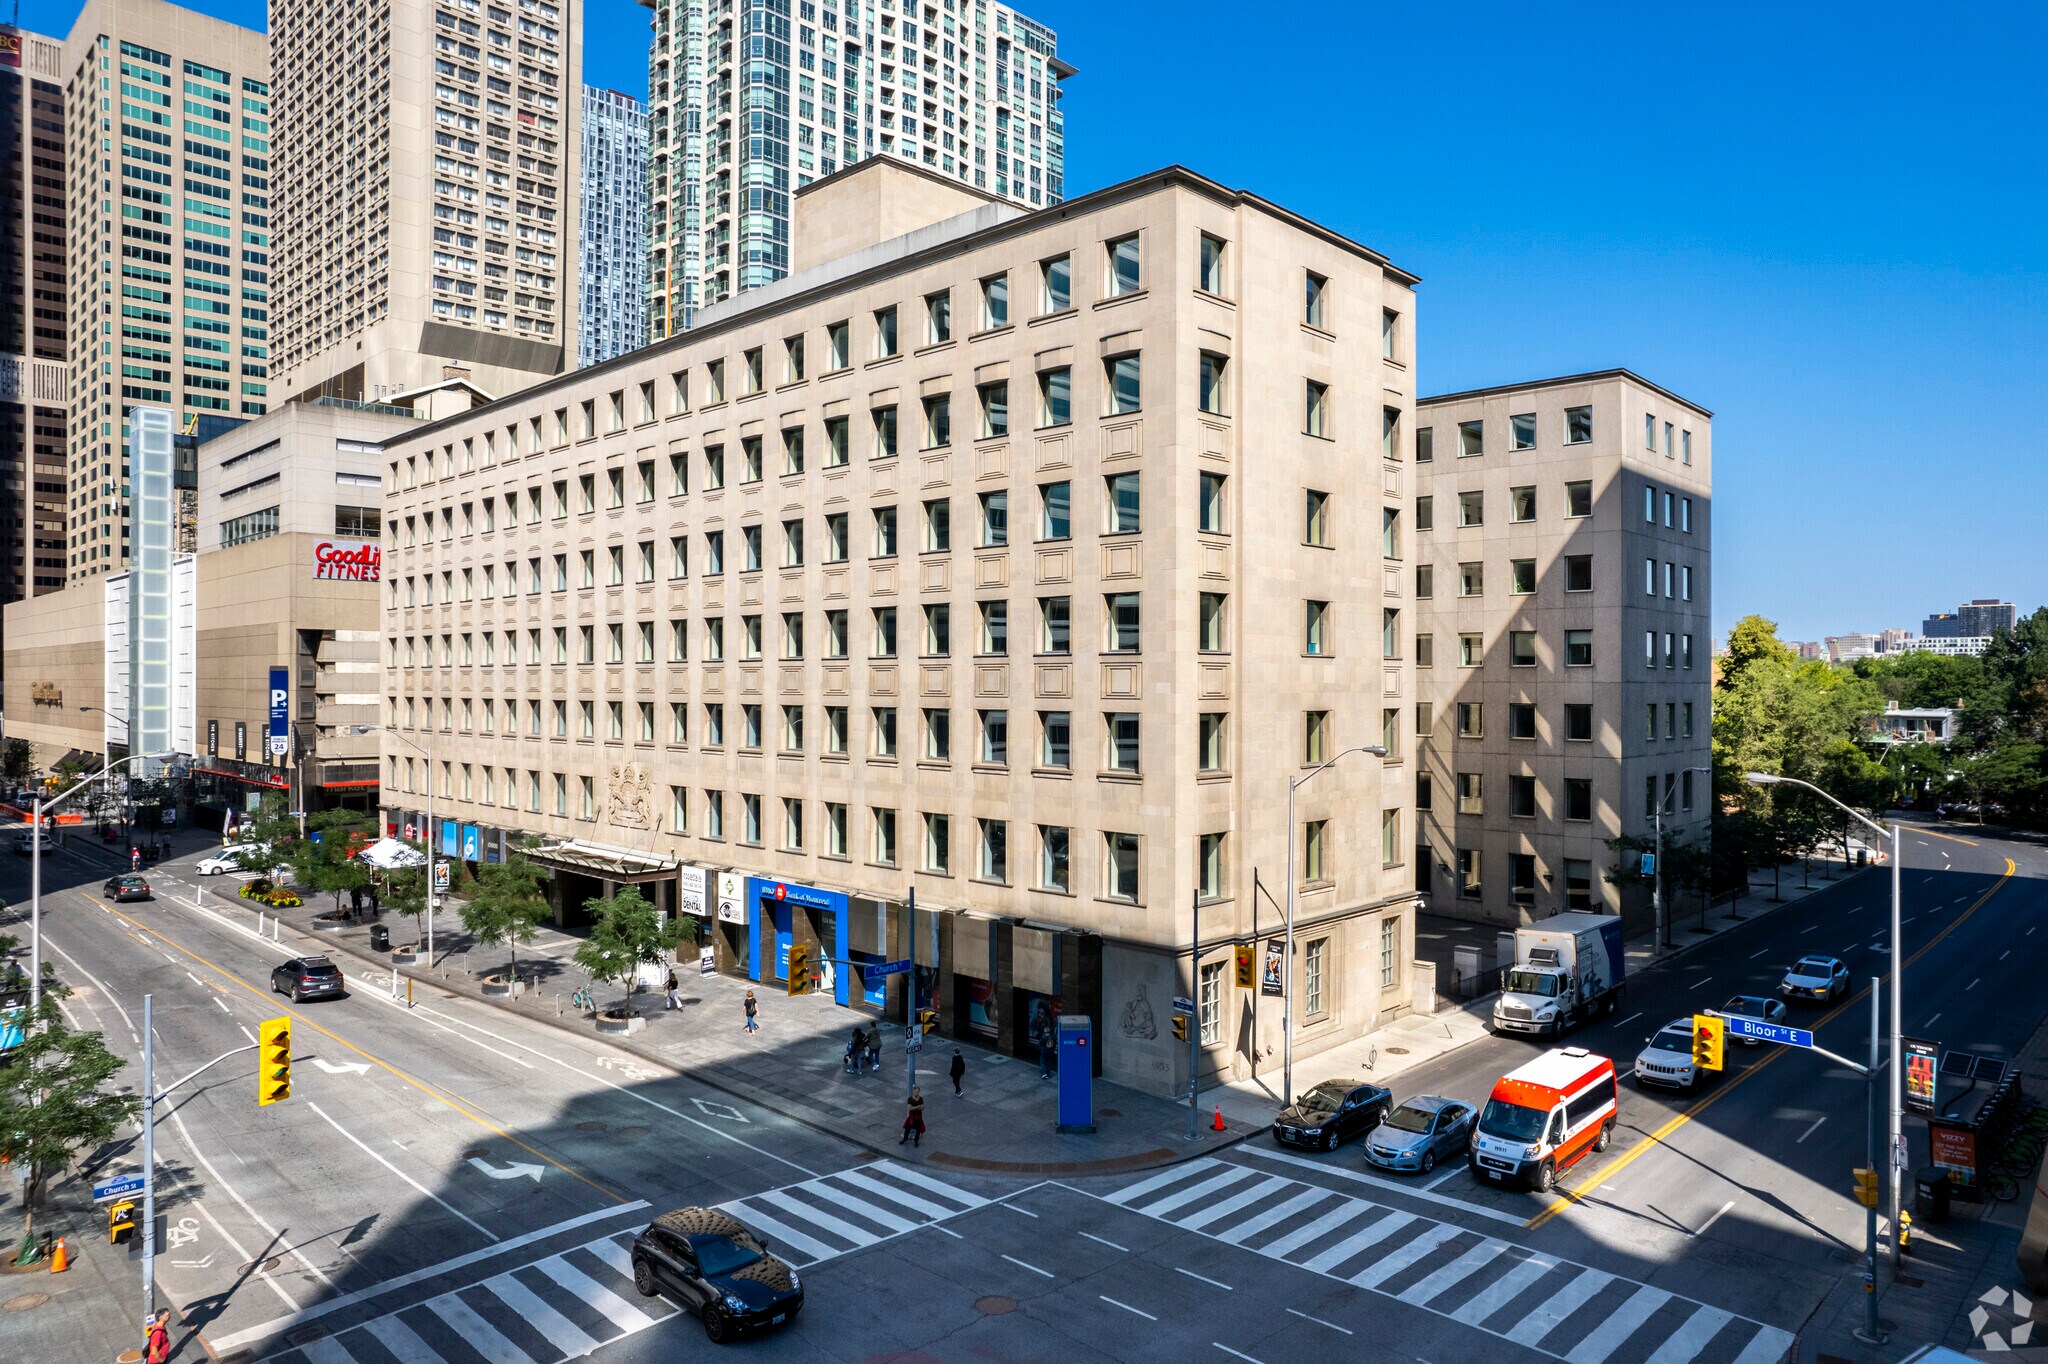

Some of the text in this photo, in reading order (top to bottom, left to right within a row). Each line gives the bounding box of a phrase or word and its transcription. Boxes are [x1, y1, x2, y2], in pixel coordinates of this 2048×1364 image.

[315, 542, 381, 566] GoodLi
[271, 689, 287, 708] P
[683, 900, 702, 912] DENTAL
[874, 963, 898, 975] Church
[1744, 1021, 1777, 1038] Bloor
[1790, 1030, 1797, 1042] E
[1152, 1060, 1170, 1072] 1953
[1940, 1133, 1965, 1142] VIZZY
[103, 1184, 130, 1196] Church
